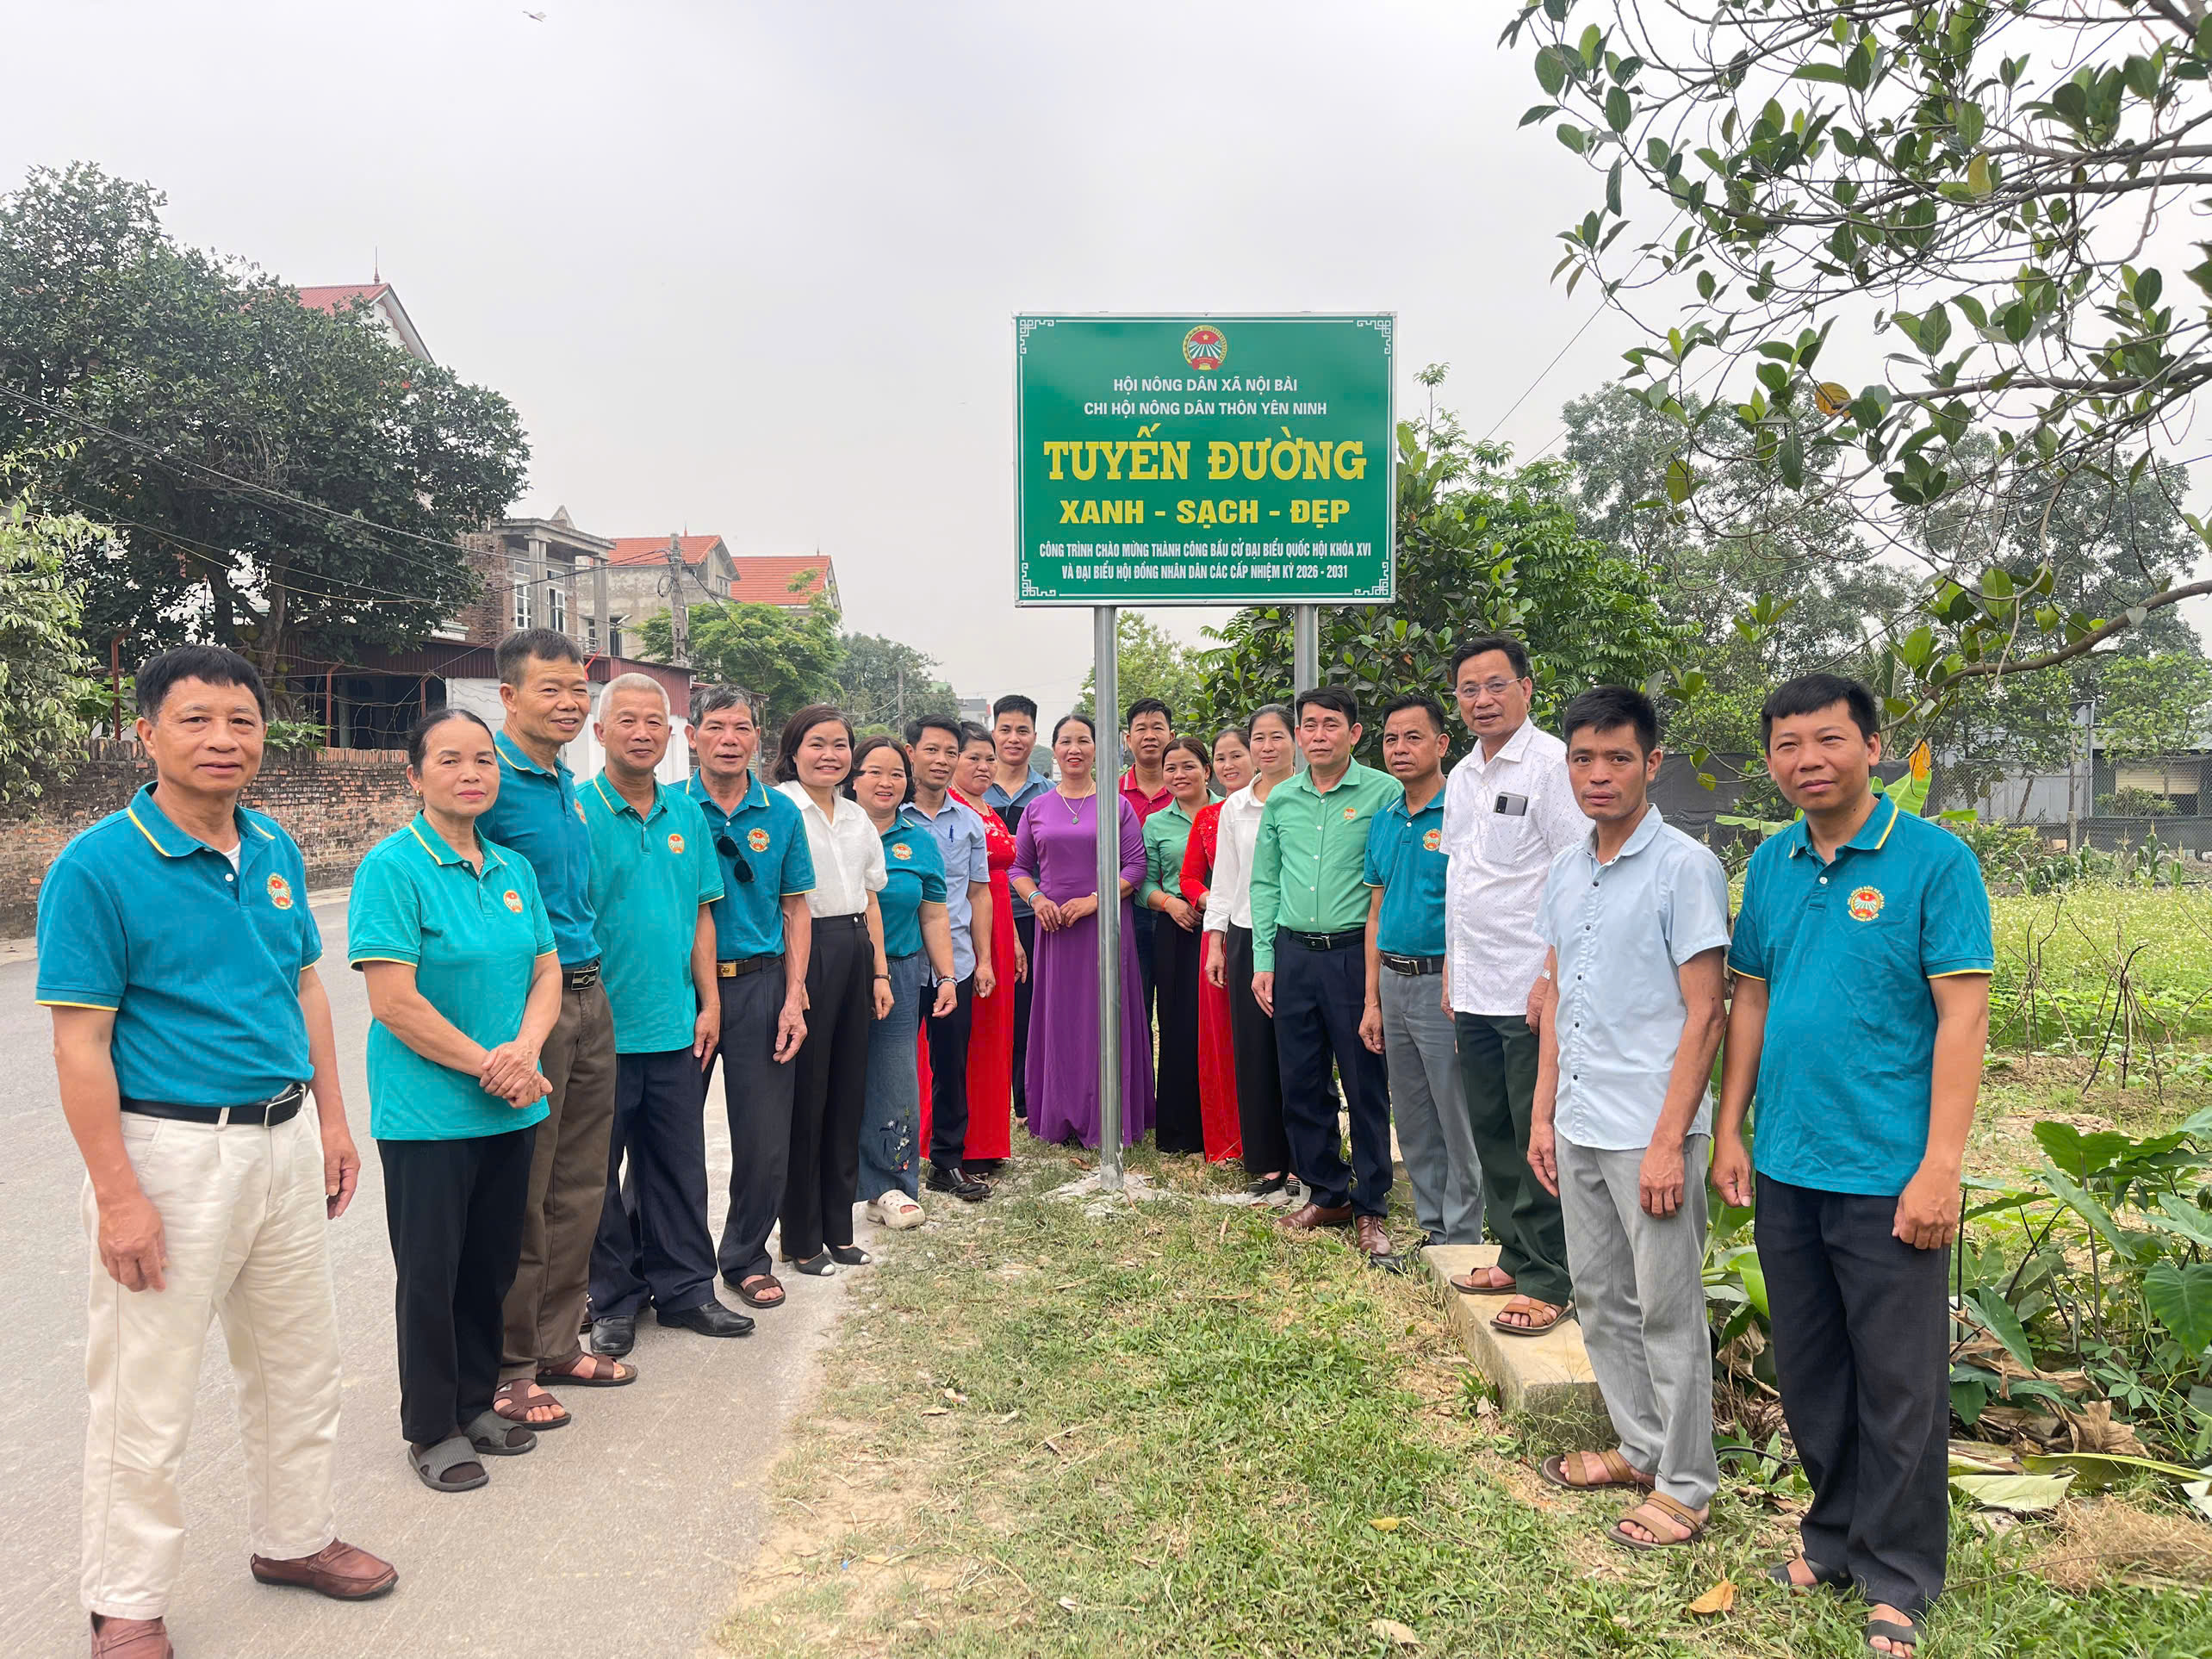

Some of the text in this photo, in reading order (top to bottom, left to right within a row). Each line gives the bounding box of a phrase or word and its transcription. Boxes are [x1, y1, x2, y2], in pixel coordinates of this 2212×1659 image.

[1114, 375, 1297, 395] HỘI NÔNG DÂN XÃ NỘI BÀI
[1084, 399, 1327, 418] CHI HỘI NÔNG DÂN THÔN YÊN NINH
[1044, 422, 1367, 480] TUYẾN ĐƯỜNG
[1059, 500, 1144, 524] XANH
[1177, 500, 1258, 528] SẠCH
[1290, 500, 1350, 528] ĐẸP
[1040, 537, 1371, 559] CÔNG TRÌNH CHÀO MỪNG THÀNH CÔNG BẦU CỬ ĐẠI BIỂU QUỐC HỘI KHÓA XVI
[1062, 562, 1074, 579] VÀ
[1076, 565, 1091, 581] ĐẠI
[1094, 560, 1115, 579] BIỂU
[1116, 562, 1132, 581] HỘI
[1134, 561, 1159, 579] ĐỒNG
[1161, 562, 1186, 579] NHÂN
[1189, 562, 1208, 578] DÂN
[1210, 562, 1228, 578] CÁC
[1231, 560, 1249, 578] CẤP
[1251, 562, 1281, 581] NHIỆM
[1296, 564, 1319, 578] 2026
[1327, 564, 1348, 578] 2031
